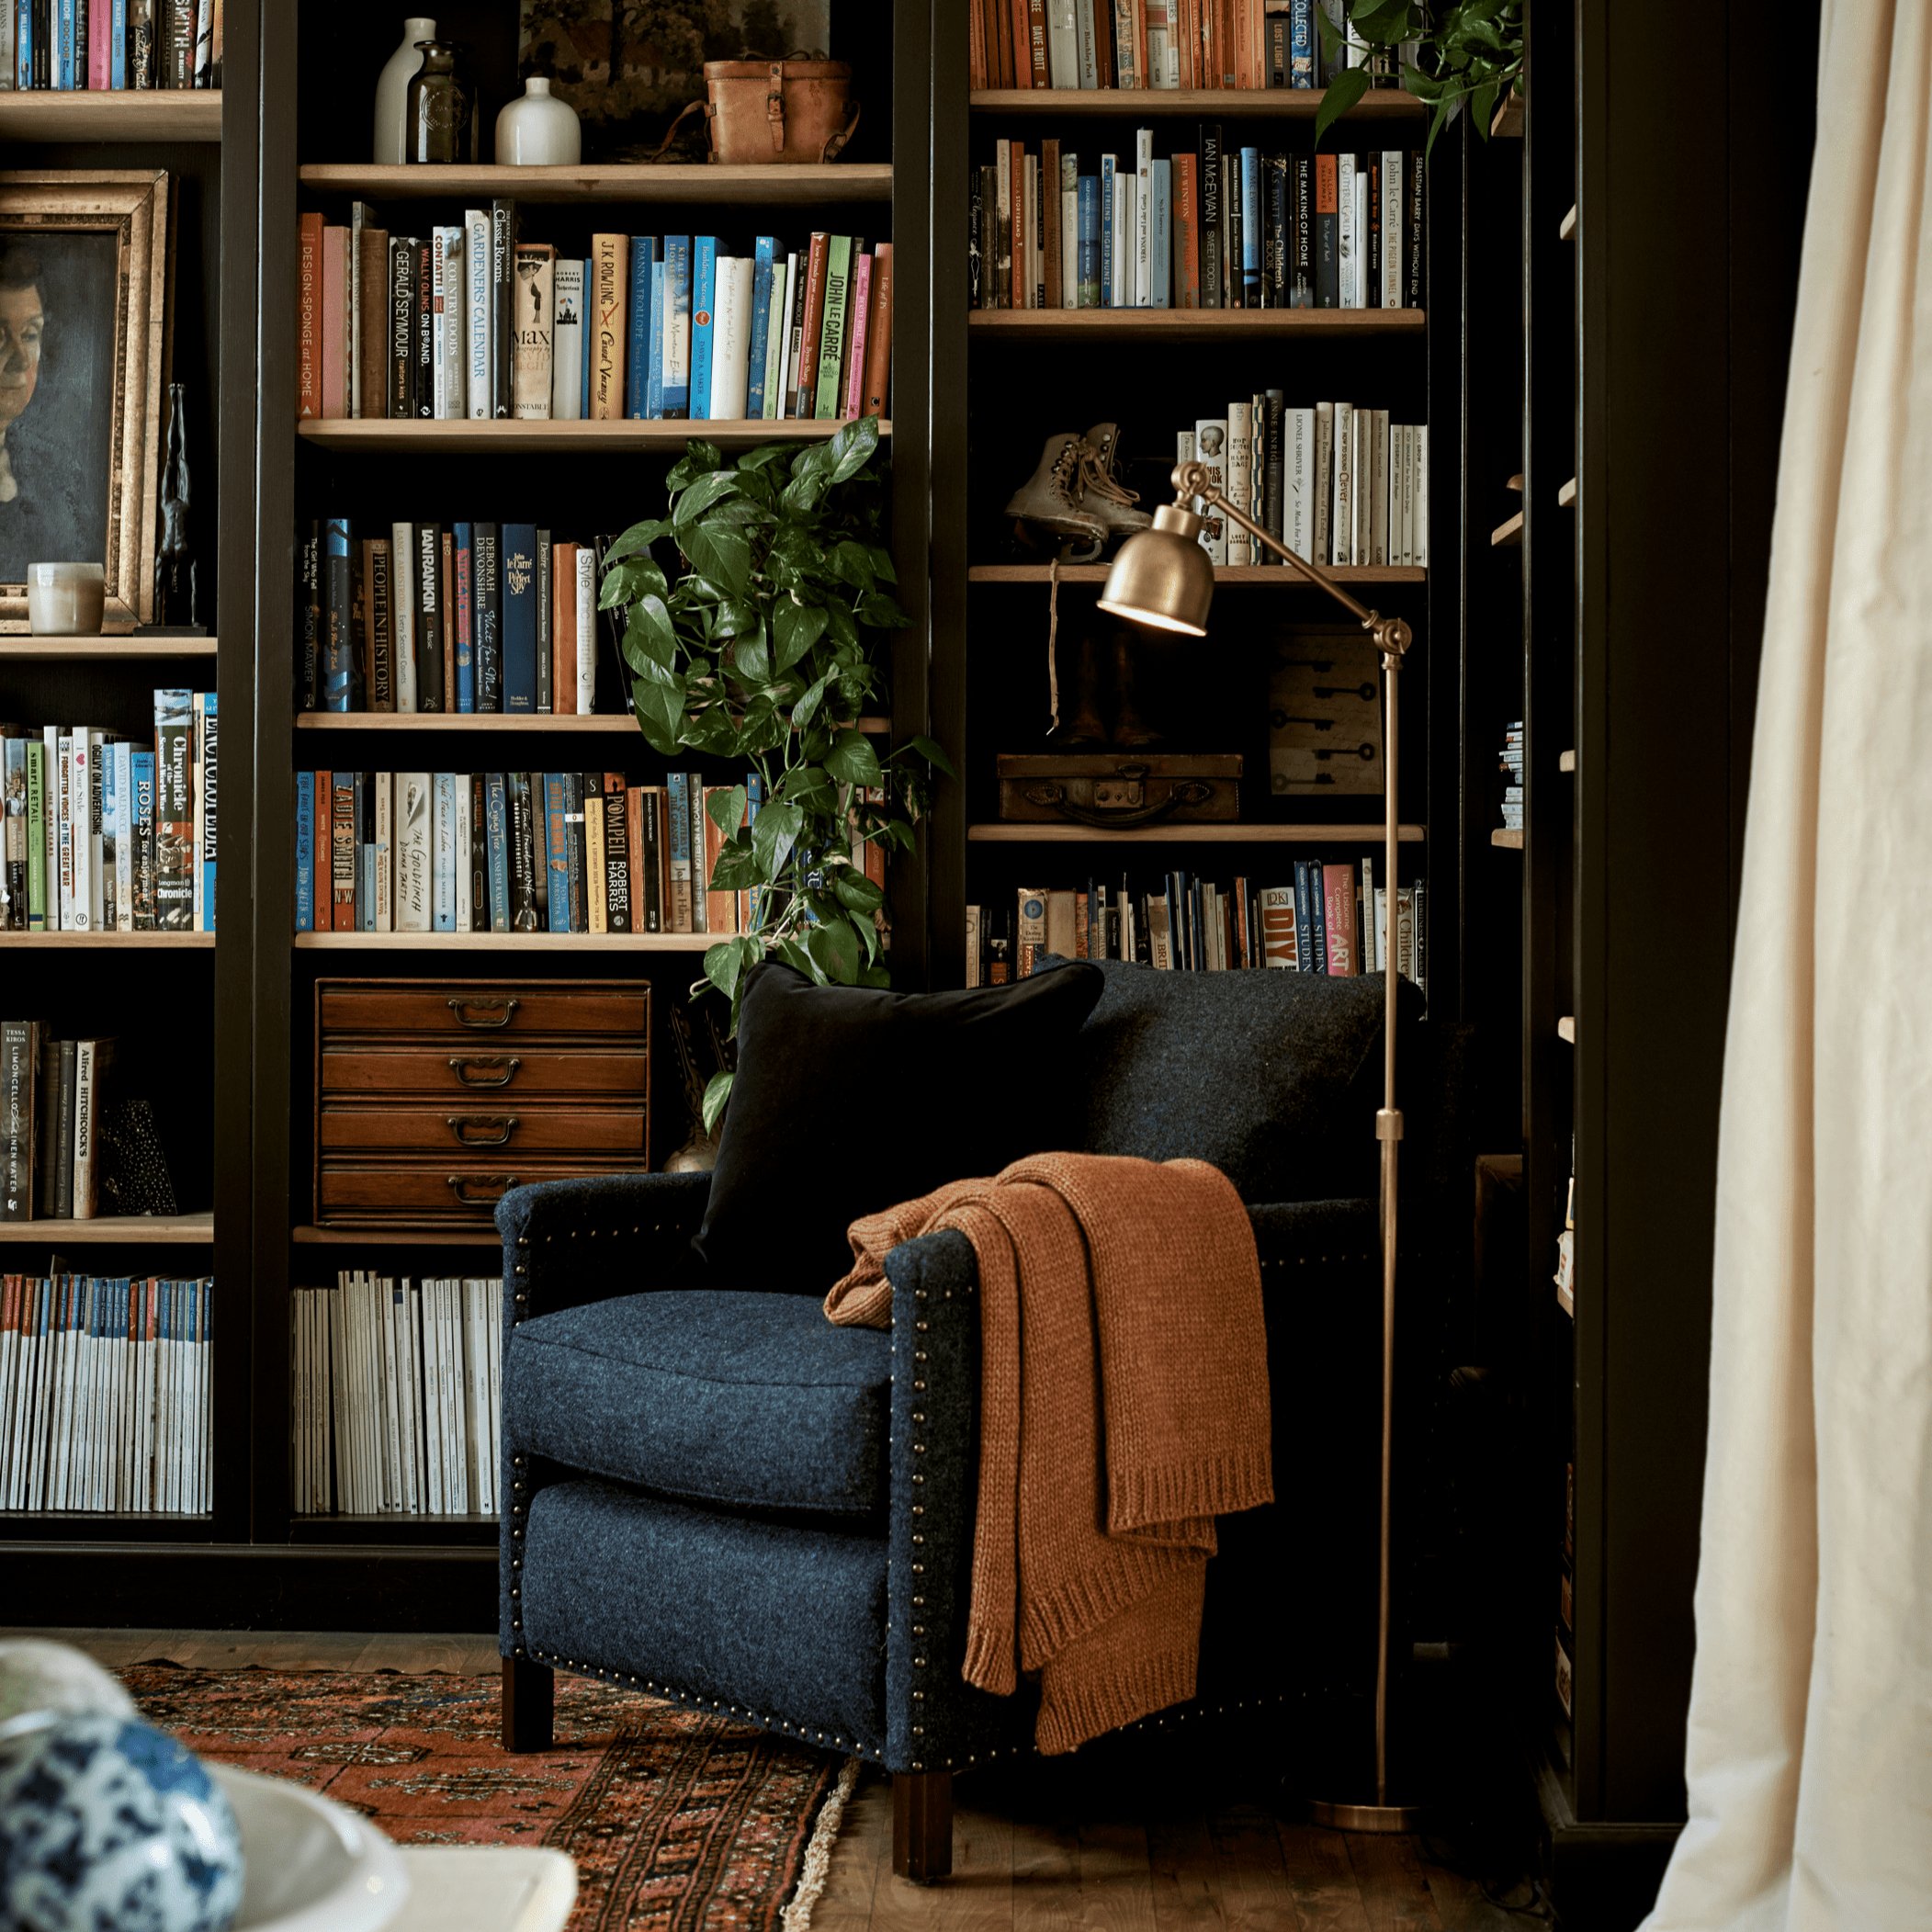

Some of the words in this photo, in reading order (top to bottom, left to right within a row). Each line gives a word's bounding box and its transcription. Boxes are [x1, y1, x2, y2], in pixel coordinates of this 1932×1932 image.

[175, 0, 190, 48] SMITH
[1033, 26, 1043, 45] DAVE
[1274, 24, 1283, 43] LOST
[1034, 47, 1045, 71] TROTT
[1204, 139, 1216, 161] IAN
[1387, 158, 1399, 184] John
[1415, 157, 1423, 196] SEBASTIAN
[1205, 164, 1216, 222] McEWAN
[1389, 187, 1399, 197] le
[495, 209, 504, 245] Classic
[972, 195, 983, 235] Elegance
[1300, 221, 1307, 235] OF
[1389, 198, 1399, 228] Carré
[601, 242, 614, 259] J.K.
[1206, 231, 1215, 258] SWEET
[1266, 240, 1274, 270] BOOK
[1300, 237, 1308, 266] HOME
[1388, 246, 1396, 269] PIGEON
[396, 251, 409, 298] GERALD
[421, 248, 429, 279] WALLY
[474, 223, 484, 304] GARDENERS'
[495, 246, 504, 283] Rooms
[1275, 240, 1283, 288] Children's
[447, 262, 458, 316] COUNTRY
[828, 272, 844, 304] JOHN
[878, 292, 887, 300] of
[396, 299, 409, 356] SEYMOUR
[830, 308, 841, 318] LE
[448, 318, 458, 356] FOODS
[474, 308, 485, 378] CALENDAR
[513, 331, 549, 345] Max
[600, 332, 615, 364] Casual
[822, 321, 840, 360] CARRÉ
[302, 348, 311, 359] at
[302, 363, 311, 396] HOME
[597, 367, 613, 404] Vacancy
[1339, 472, 1350, 503] Clever
[1294, 500, 1301, 508] So
[422, 529, 434, 554] IAN
[477, 537, 485, 610] DEVONSHIRE
[486, 537, 494, 592] DEBORAH
[374, 556, 387, 609] PEOPLE
[422, 555, 435, 613] RANKIN
[304, 605, 313, 639] SIMON
[375, 613, 387, 628] IN
[484, 610, 495, 643] Wait
[304, 643, 313, 683] MAWER
[376, 632, 389, 700] HISTORY
[481, 645, 496, 664] for
[485, 667, 497, 699] Me!
[92, 744, 102, 771] OGILVY
[158, 737, 166, 764] Second
[30, 752, 39, 785] smart
[92, 773, 102, 784] ON
[158, 765, 166, 797] World
[166, 763, 173, 772] of
[173, 736, 187, 811] Chronicle
[490, 776, 503, 798] The
[30, 789, 39, 824] RETAIL
[92, 785, 102, 834] ADVERTISING
[138, 781, 152, 836] ROSES
[334, 785, 353, 830] ZADIE
[489, 800, 503, 832] Crying
[493, 829, 504, 850] Tree
[606, 795, 625, 855] POMPEII
[334, 835, 353, 880] SMITH
[400, 842, 410, 868] DONNA
[141, 855, 150, 902] enjoyment
[608, 862, 618, 911] HARRIS
[617, 861, 627, 911] ROBERT
[675, 868, 685, 897] Joanne
[678, 898, 687, 926] Harris
[1327, 897, 1335, 918] Book
[1334, 887, 1342, 930] Complete
[1263, 909, 1297, 962] DIY
[1330, 934, 1349, 971] ART
[81, 1049, 89, 1081] Alfred
[79, 1087, 88, 1157] HITCHCOCK'S
[10, 1130, 18, 1158] LINEN
